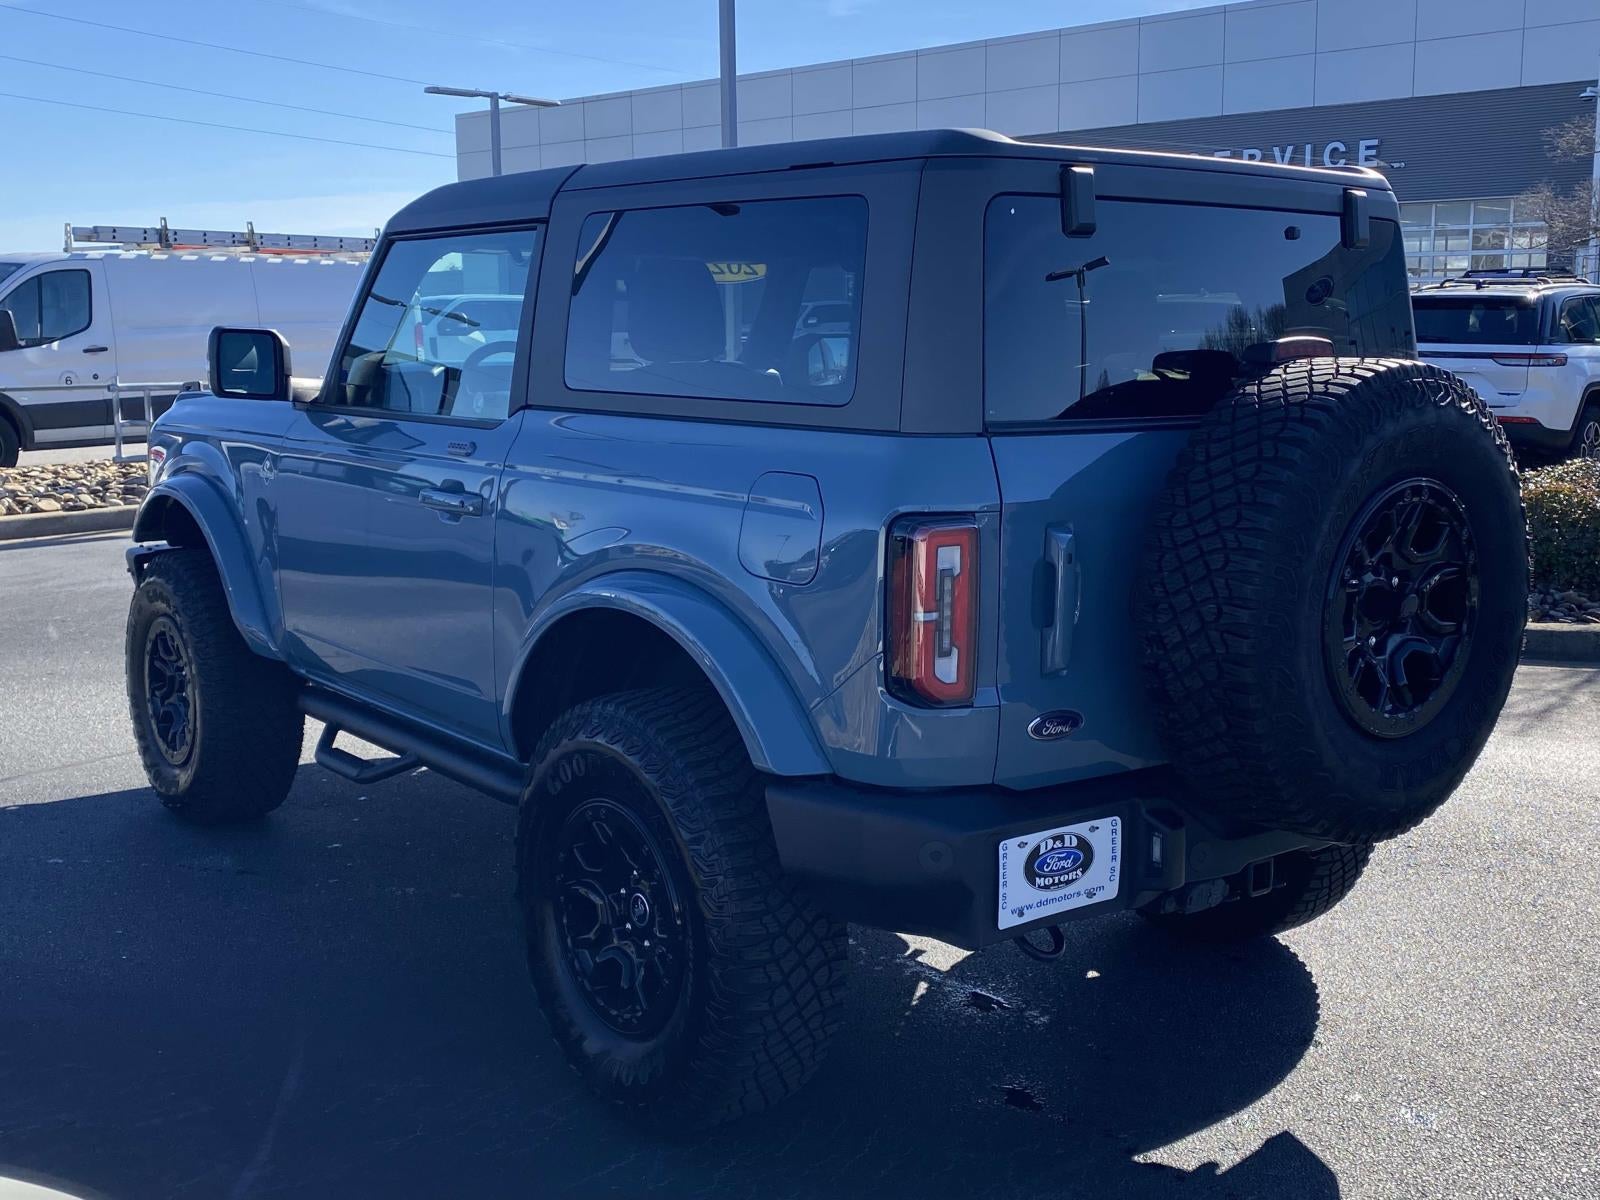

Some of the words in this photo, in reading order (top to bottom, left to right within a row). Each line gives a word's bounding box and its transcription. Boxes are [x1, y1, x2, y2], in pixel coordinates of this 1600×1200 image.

[1190, 138, 1379, 168] RVICE
[1042, 719, 1072, 735] Ford
[1043, 852, 1074, 872] Ford
[1035, 868, 1083, 887] MOTORS
[1109, 866, 1116, 882] SC
[1002, 893, 1008, 910] SC
[1010, 885, 1105, 915] www.ddmotors.com
